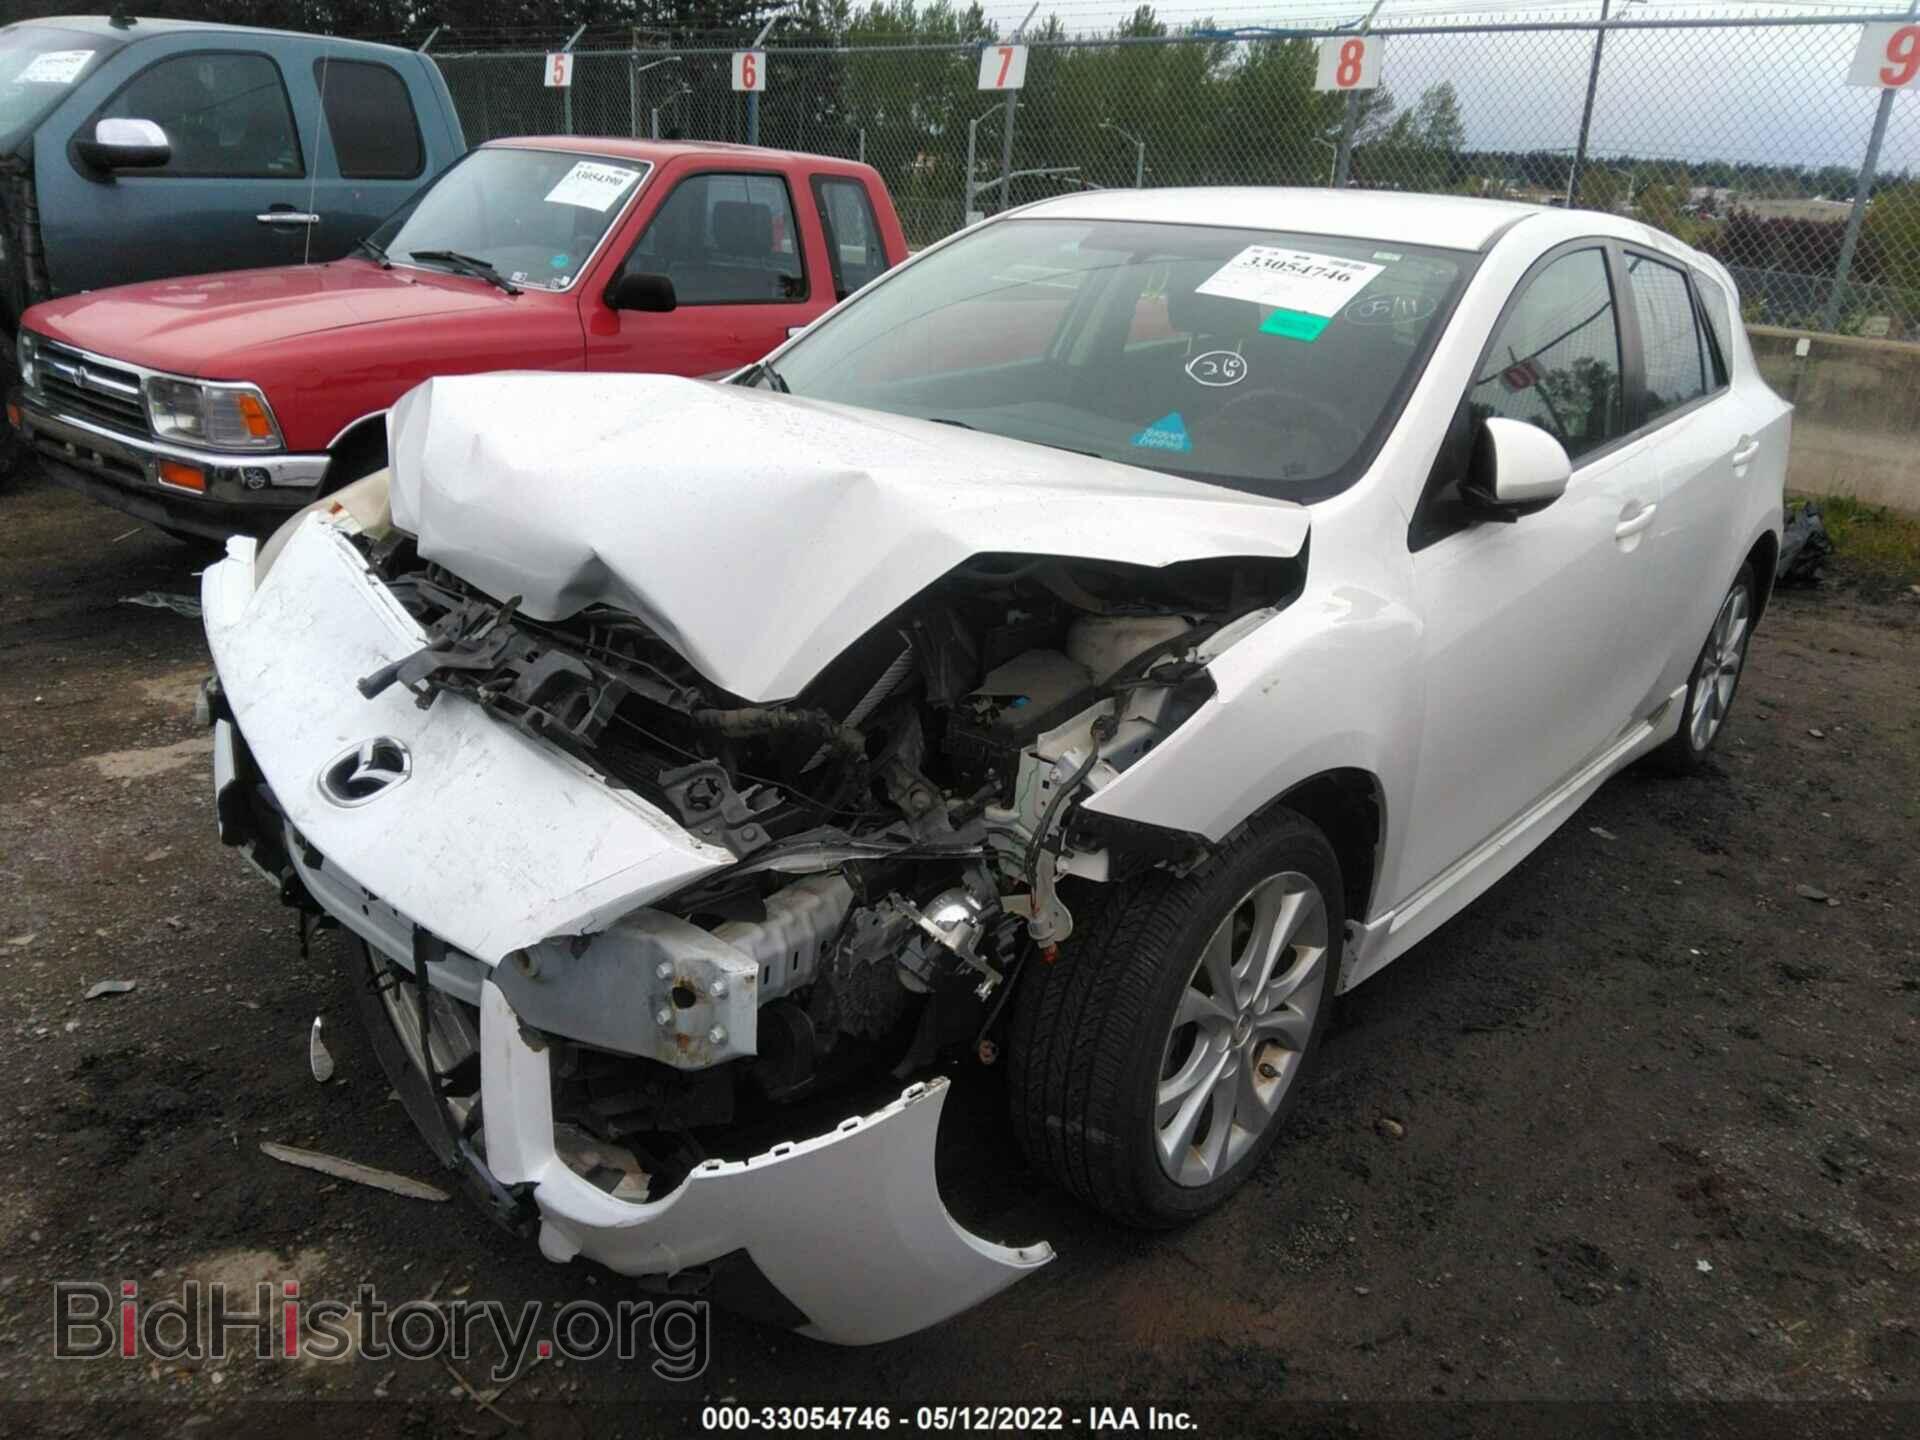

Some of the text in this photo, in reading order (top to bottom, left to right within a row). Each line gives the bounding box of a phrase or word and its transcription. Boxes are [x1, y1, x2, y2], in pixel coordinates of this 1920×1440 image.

[553, 55, 565, 84] 5
[742, 52, 756, 89] 6
[996, 47, 1014, 88] 7
[1336, 38, 1365, 88] 8
[1880, 25, 1920, 86] 9
[1242, 255, 1352, 283] 33054746
